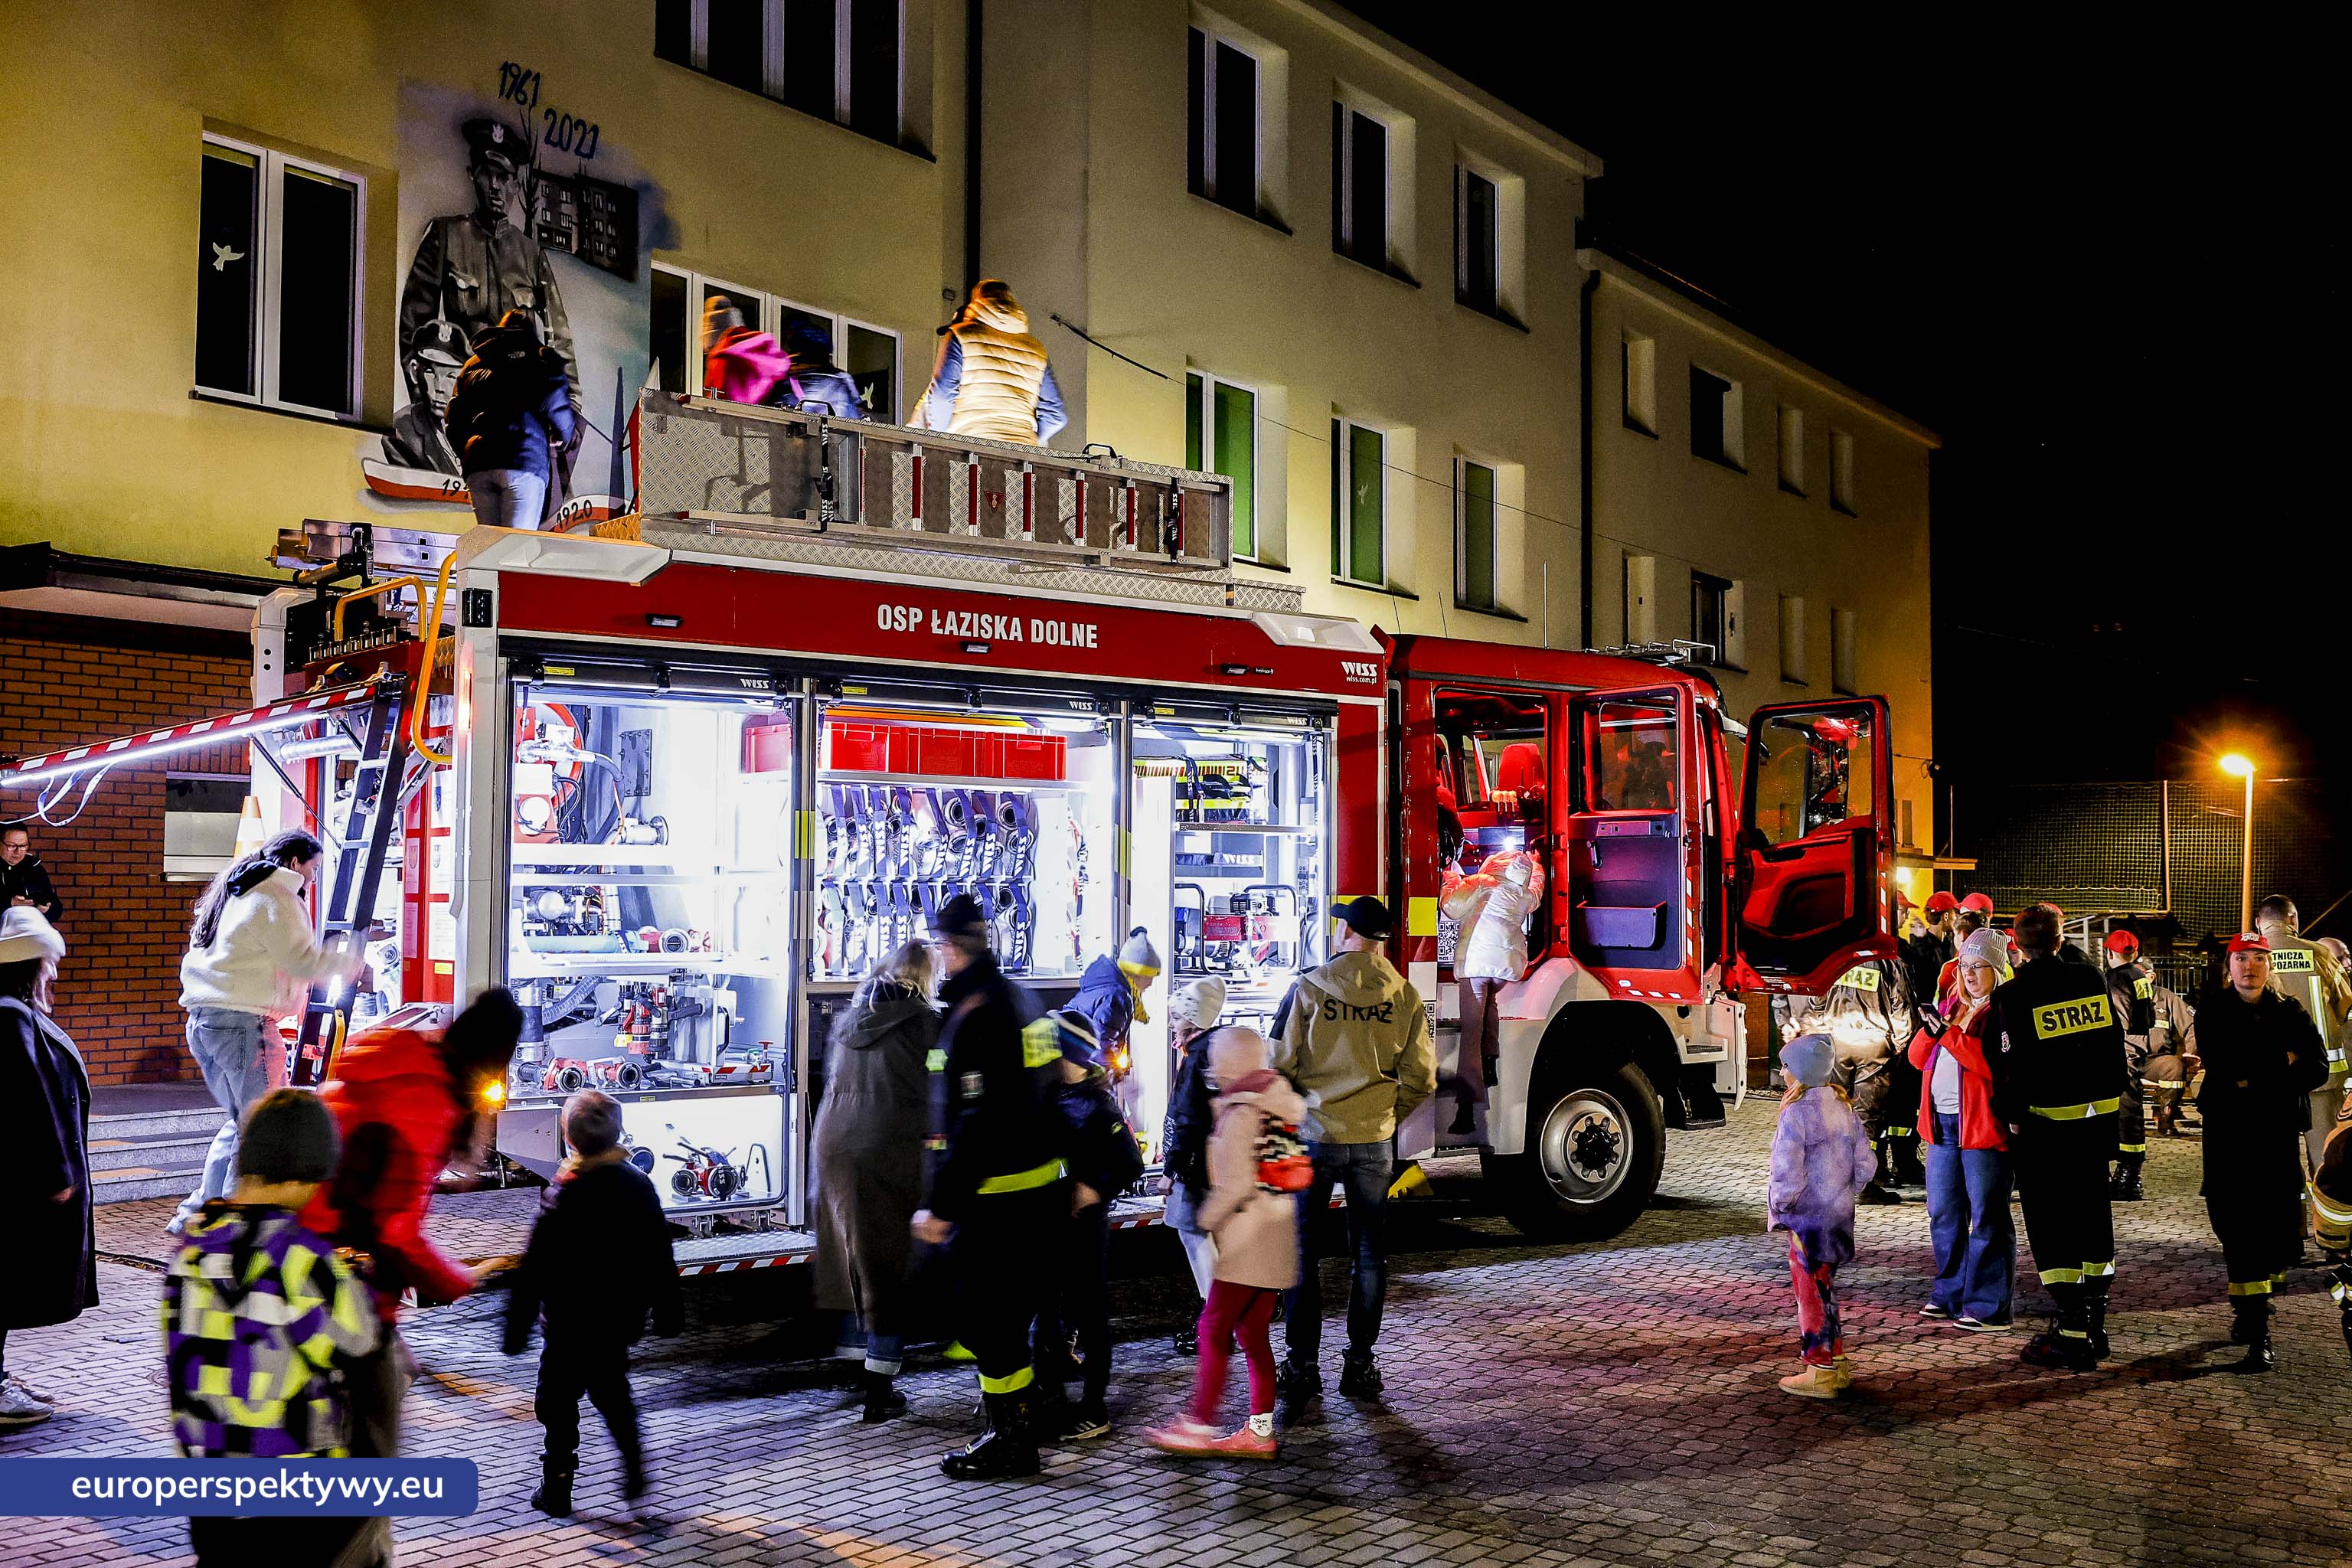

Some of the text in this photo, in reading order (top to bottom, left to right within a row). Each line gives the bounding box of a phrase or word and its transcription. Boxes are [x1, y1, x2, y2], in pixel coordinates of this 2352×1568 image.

[498, 60, 541, 107] 1961
[544, 107, 599, 159] 2021
[557, 499, 593, 529] 1920
[877, 604, 1098, 648] OSP ŁAZISKA DOLNE
[740, 678, 769, 689] WISS
[1341, 661, 1377, 677] WISS
[1346, 676, 1377, 685] wiss.com.pl
[1069, 701, 1093, 710] WISS
[874, 821, 887, 864] WISS
[900, 825, 910, 867] WISS
[932, 834, 948, 876] WISS
[959, 838, 975, 878] WISS
[982, 833, 995, 874] WISS
[1014, 836, 1027, 877] WISS
[1014, 921, 1026, 962] WISS
[2272, 952, 2304, 961] TNICZA
